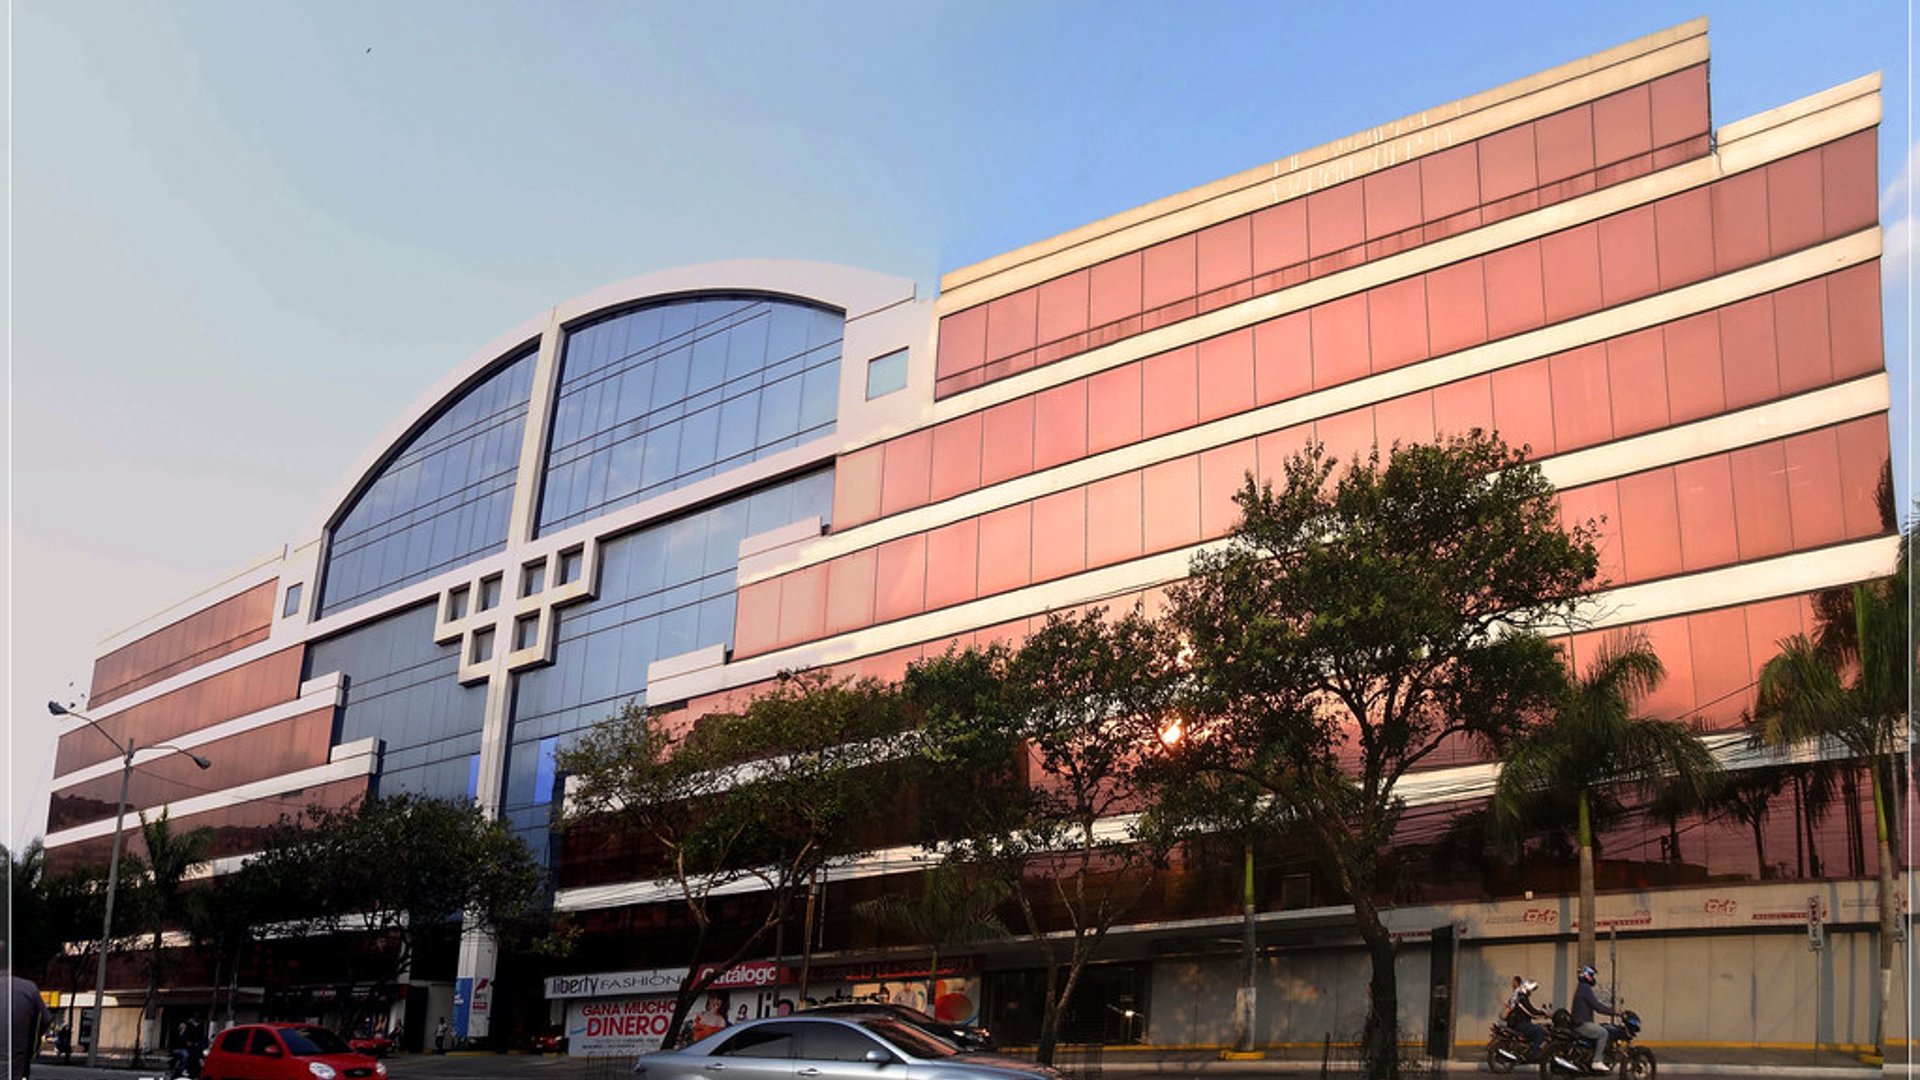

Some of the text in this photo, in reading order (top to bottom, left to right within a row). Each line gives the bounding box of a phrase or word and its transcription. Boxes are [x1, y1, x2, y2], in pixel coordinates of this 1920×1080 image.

[552, 975, 680, 995] liberty FASHION
[582, 1000, 677, 1016] GANA MUCHO
[587, 1014, 669, 1037] DINERO
